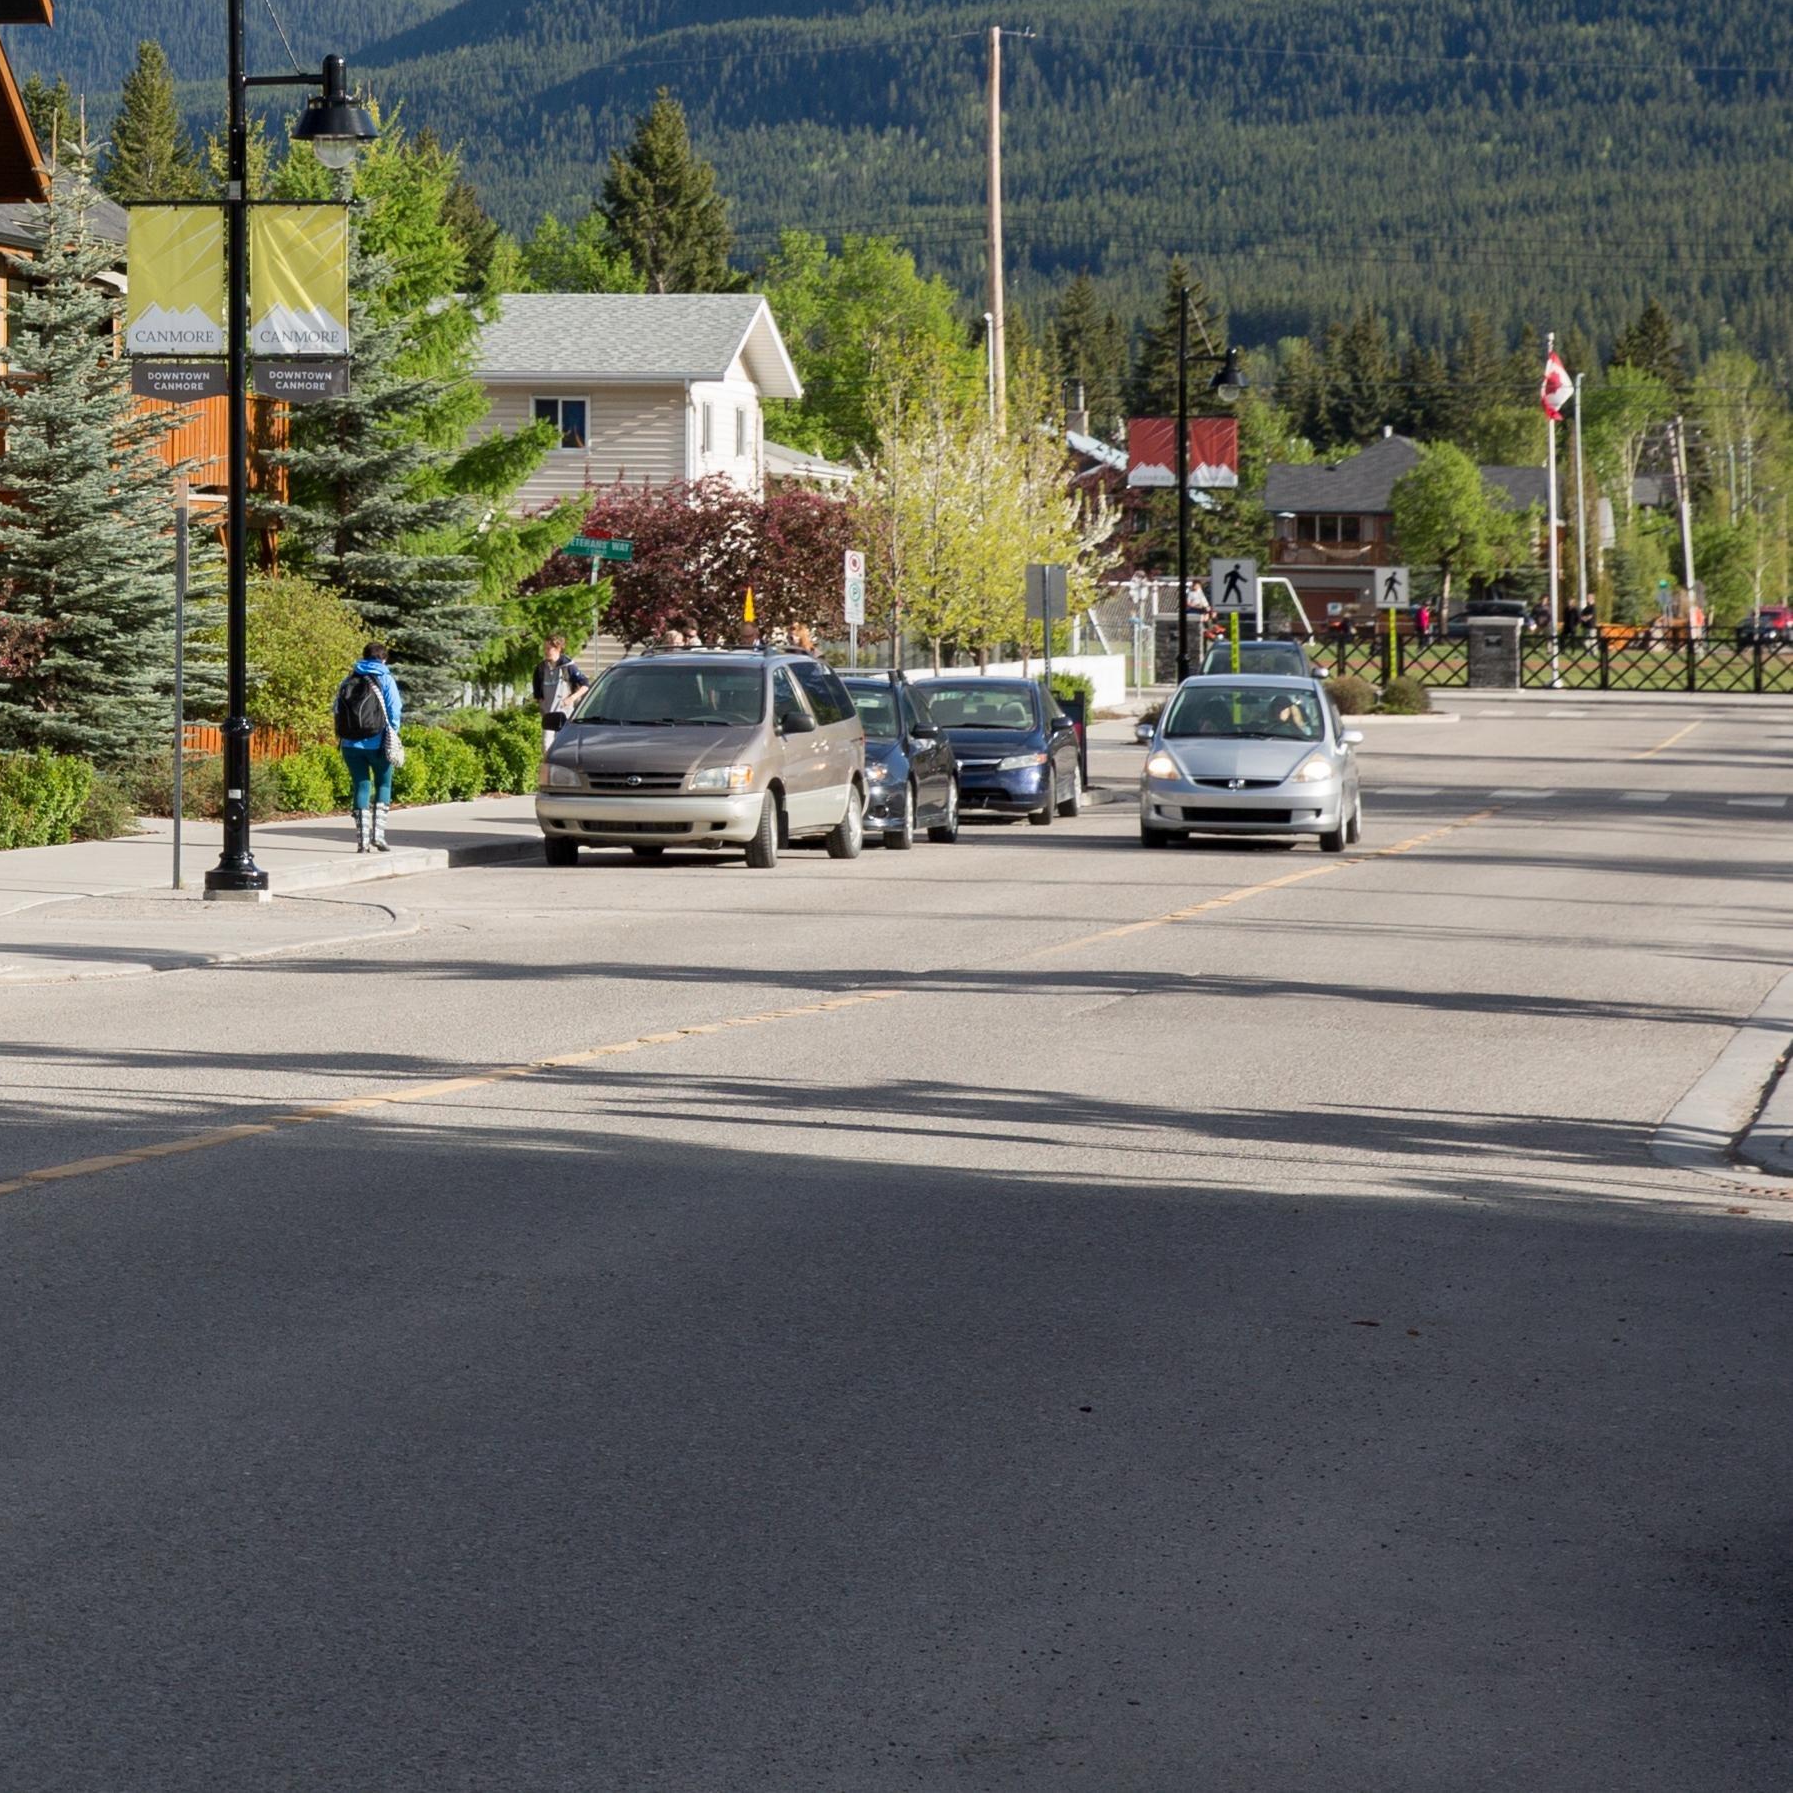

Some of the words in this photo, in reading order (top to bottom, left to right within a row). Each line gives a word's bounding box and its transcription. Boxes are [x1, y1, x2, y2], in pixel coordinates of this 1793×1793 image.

[135, 330, 214, 343] CANMORE
[260, 330, 339, 343] CANMORE
[147, 371, 210, 380] DOWNTOWN
[269, 371, 332, 380] DOWNTOWN
[154, 381, 204, 391] CANMORE
[275, 381, 325, 391] CANMORE
